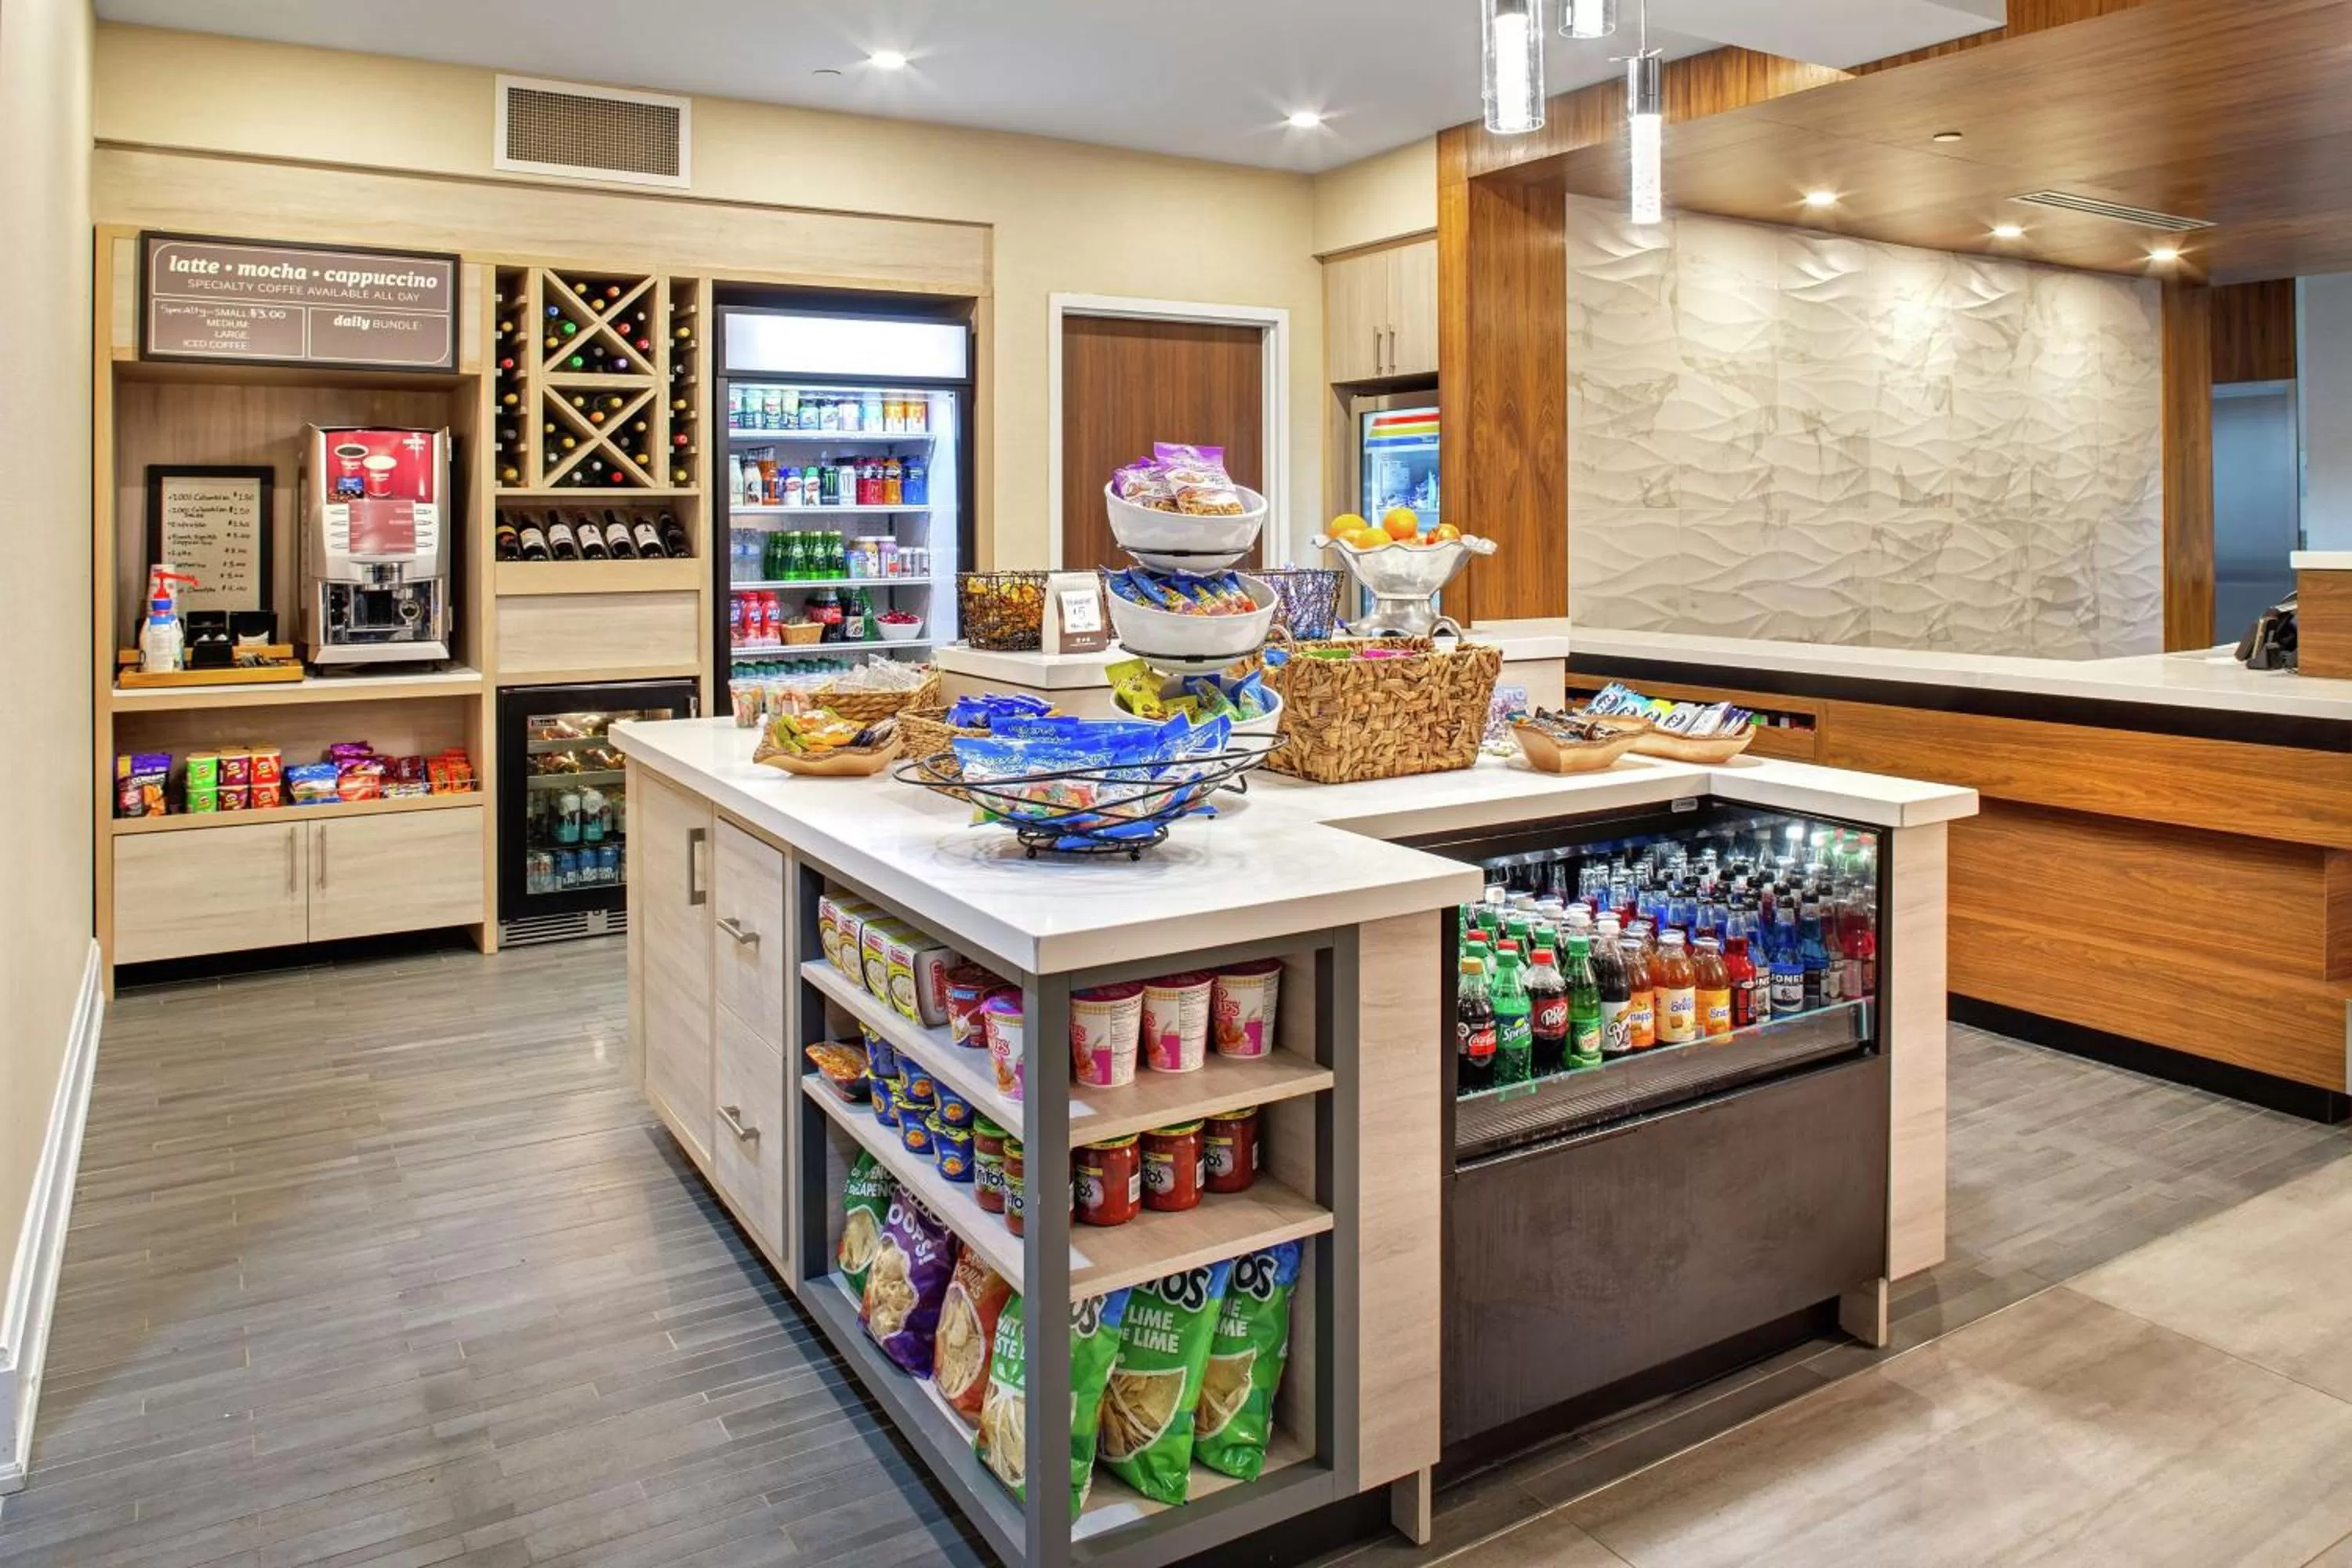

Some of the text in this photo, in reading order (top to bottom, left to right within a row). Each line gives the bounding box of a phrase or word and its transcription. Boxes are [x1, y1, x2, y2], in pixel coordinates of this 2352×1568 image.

[169, 255, 438, 289] latte mocha cappuccino
[187, 278, 420, 302] SPECIALTY COFFEE AVAILABLE ALL DAY
[333, 314, 371, 331] daily
[183, 339, 208, 348] ICED
[1128, 1305, 1174, 1331] LIME
[1133, 1334, 1179, 1355] LIME
